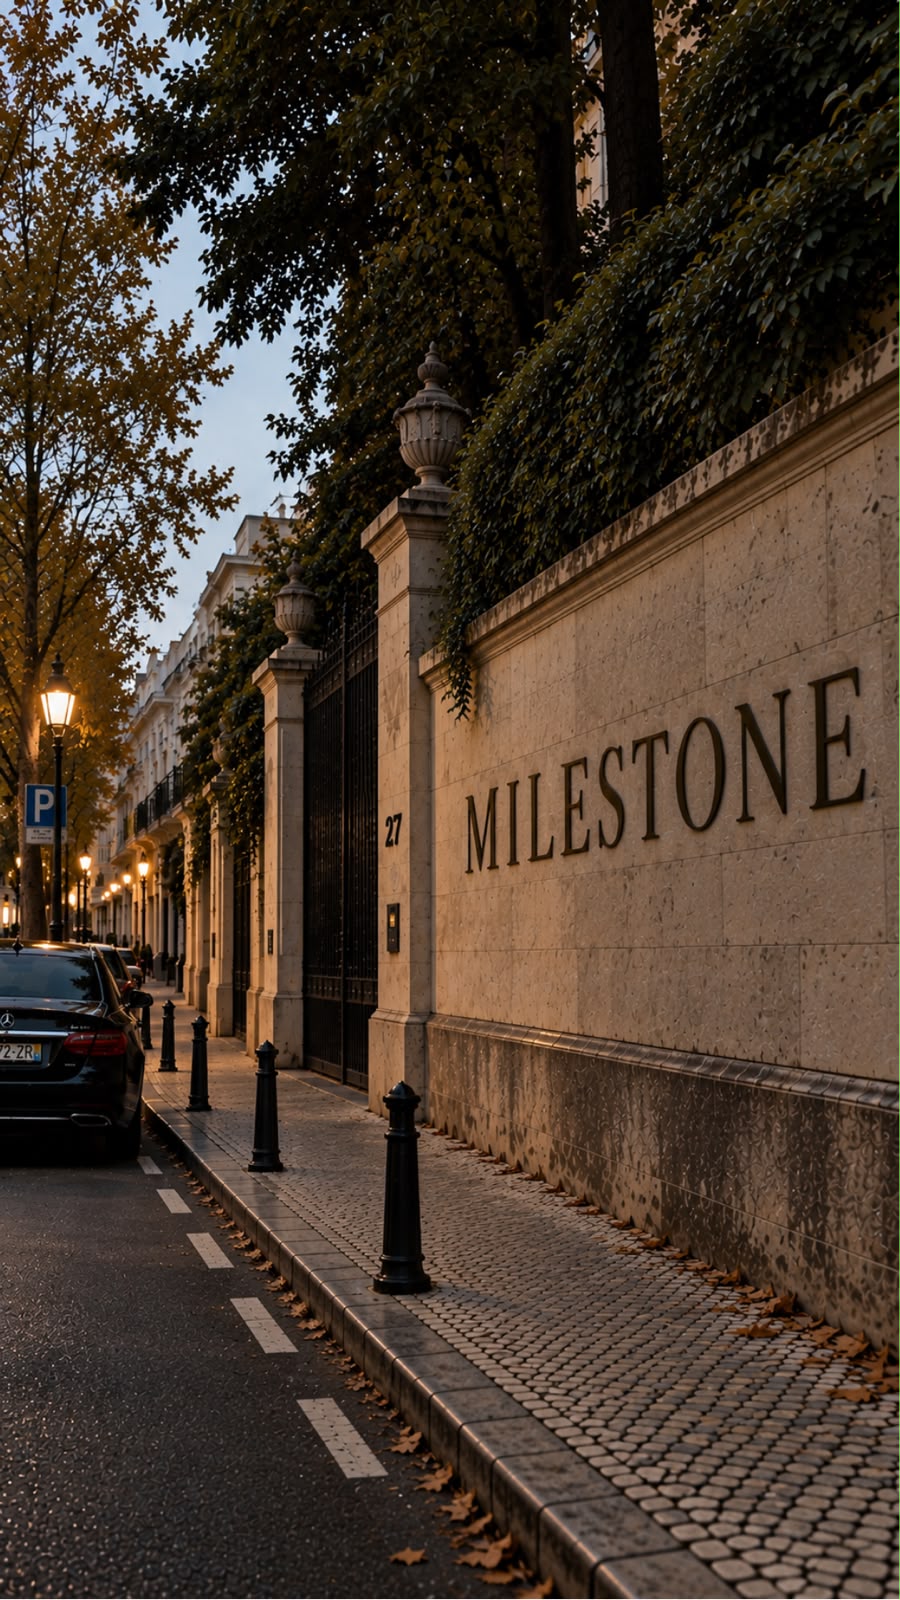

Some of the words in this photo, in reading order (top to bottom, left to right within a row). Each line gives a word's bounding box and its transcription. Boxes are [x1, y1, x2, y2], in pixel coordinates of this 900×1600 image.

[465, 666, 866, 874] MILESTONE
[34, 788, 55, 823] P
[385, 812, 402, 847] 27
